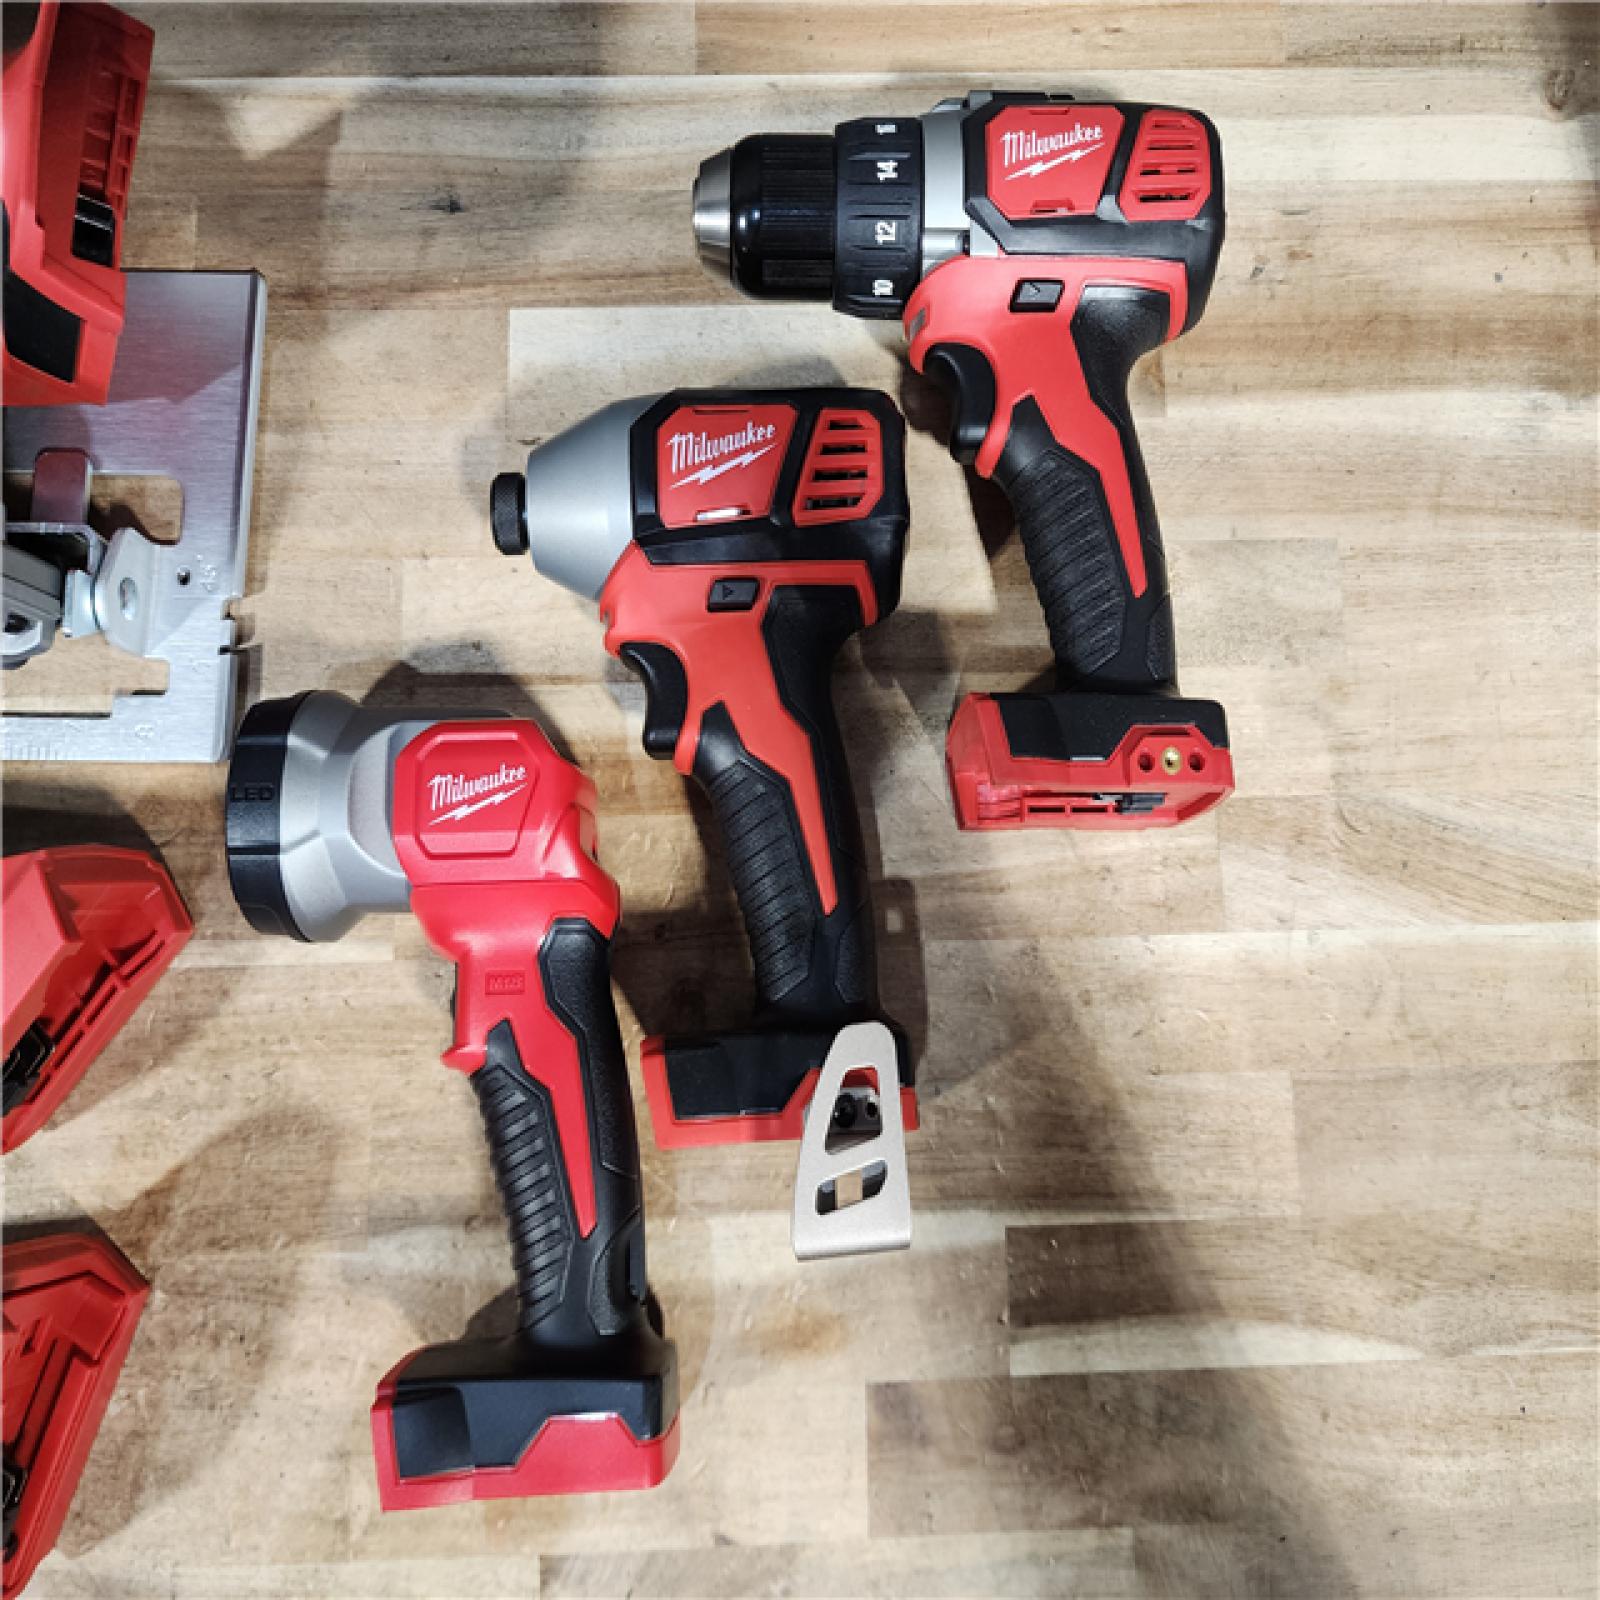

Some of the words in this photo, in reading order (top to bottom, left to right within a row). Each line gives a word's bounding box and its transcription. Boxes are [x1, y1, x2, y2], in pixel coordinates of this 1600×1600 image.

[1001, 121, 1104, 168] Milwaukee
[876, 160, 898, 182] 14
[874, 220, 896, 245] 12
[666, 419, 776, 475] Milwaukee
[229, 785, 275, 803] LED
[427, 762, 528, 812] Milwaukee
